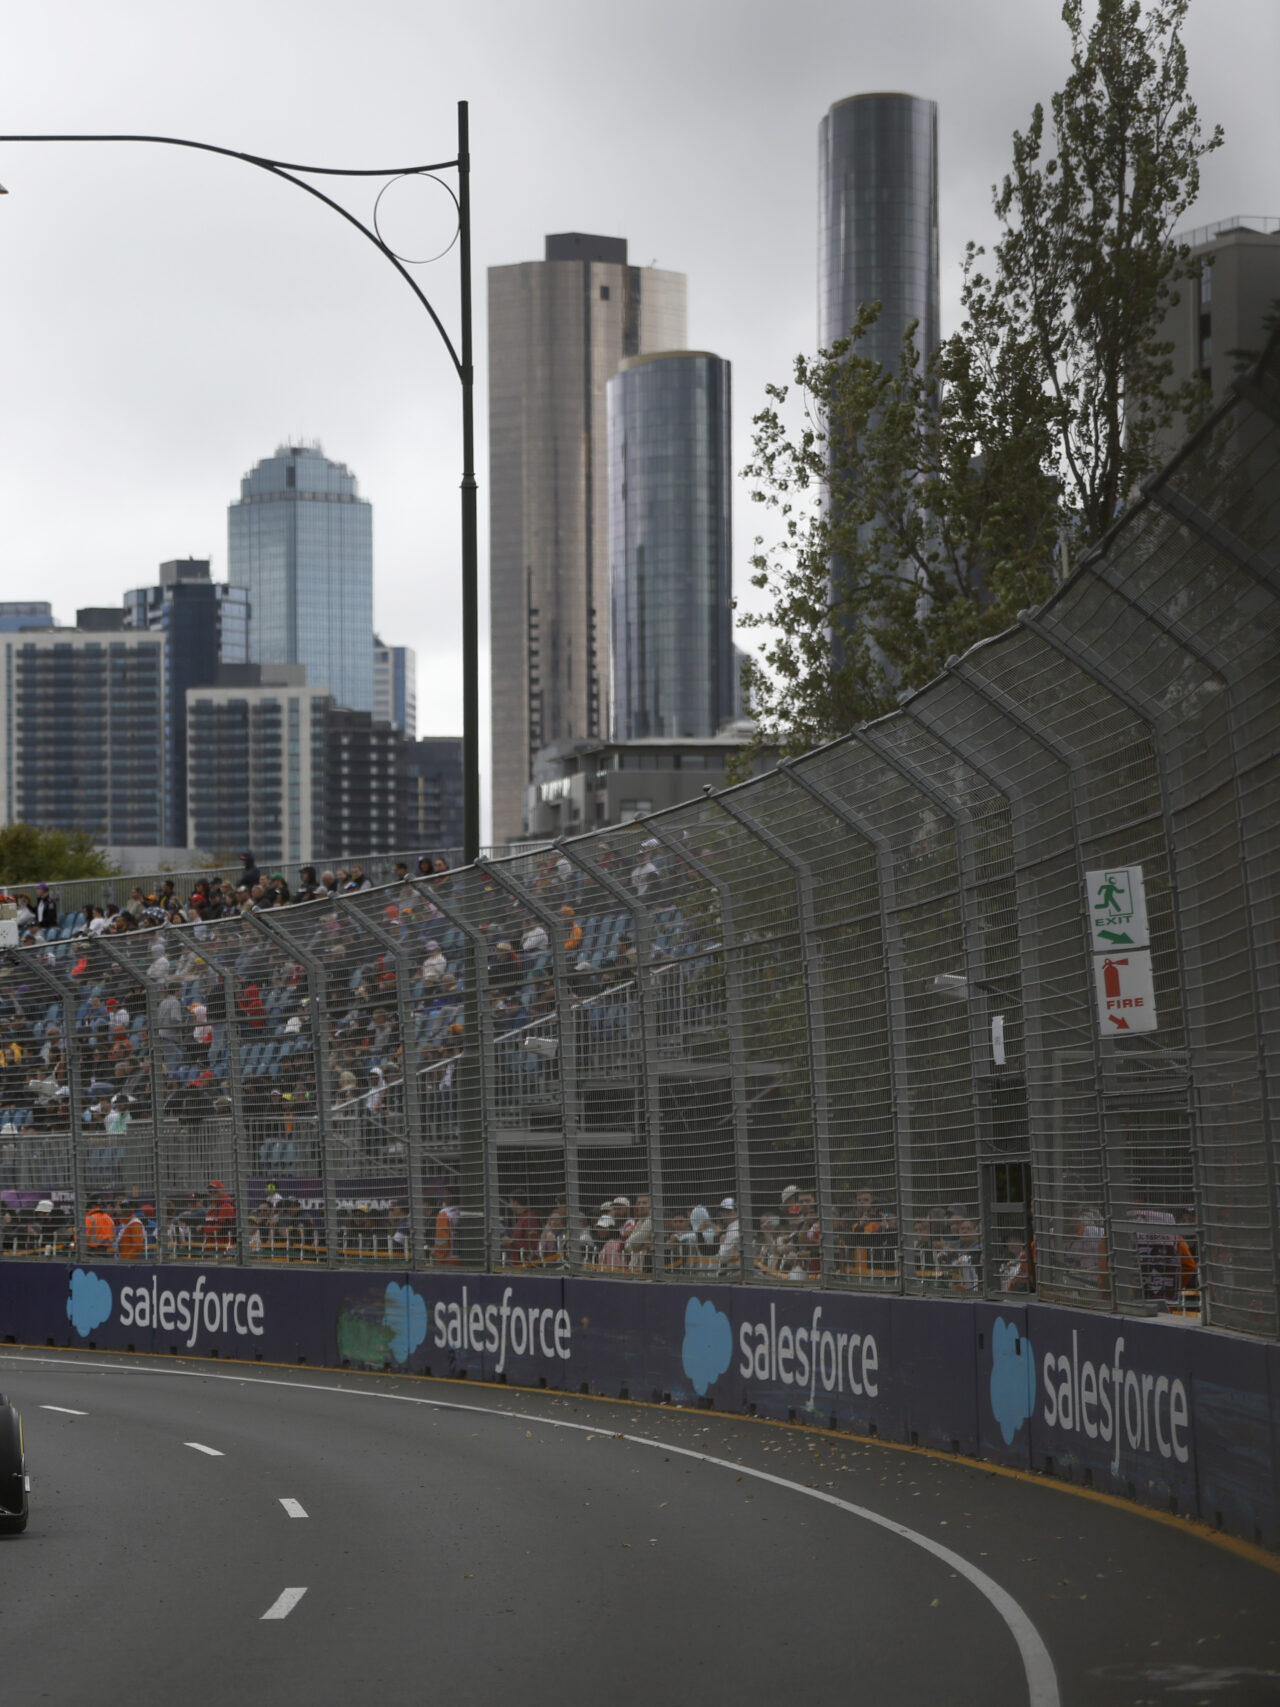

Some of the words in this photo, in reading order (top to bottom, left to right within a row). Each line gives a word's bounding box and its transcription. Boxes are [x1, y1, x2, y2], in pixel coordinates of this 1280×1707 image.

[1095, 916, 1132, 927] EXIT
[1106, 997, 1144, 1010] FIRE
[118, 1274, 266, 1348] salesforce
[433, 1285, 573, 1374] salesforce
[739, 1302, 880, 1412] salesforce
[1042, 1329, 1190, 1477] salesforce
